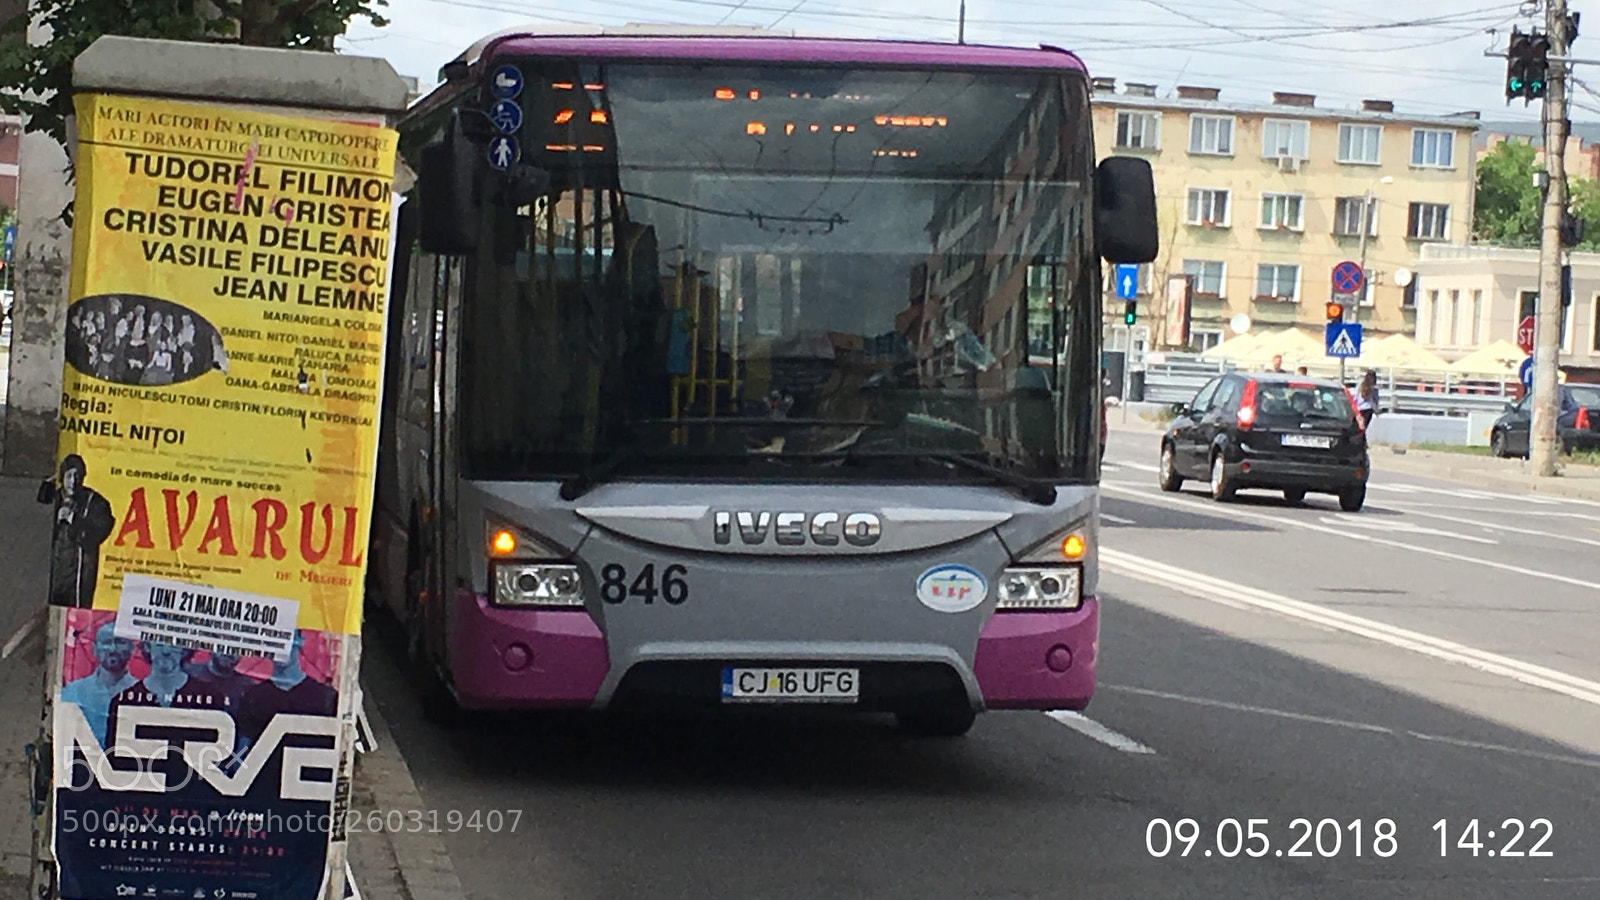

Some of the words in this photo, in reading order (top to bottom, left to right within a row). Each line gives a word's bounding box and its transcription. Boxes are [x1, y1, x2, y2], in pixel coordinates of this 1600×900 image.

[99, 106, 141, 124] MARI
[146, 112, 209, 131] ACTORI
[238, 122, 280, 138] MARI
[284, 127, 388, 152] CAPODOPERE
[107, 127, 138, 142] ALE
[143, 130, 273, 158] DRAMATURGEI
[279, 146, 380, 170] UNIVERSALE
[125, 152, 270, 190] TUDOREL
[158, 185, 264, 218] EUGEN
[103, 208, 249, 245] CRISTINA
[259, 224, 388, 261] DELEANU
[141, 240, 241, 272] VASILE
[250, 252, 386, 287] FILIPESCU
[213, 275, 288, 304] JEAN
[297, 286, 385, 314] LEMNE
[263, 310, 341, 328] MARIANGELA
[220, 326, 263, 341] DANIEL
[302, 335, 345, 349] DANIEL
[294, 347, 341, 362] RALUCA
[61, 392, 114, 415] Regia:
[73, 382, 105, 395] MIHAI
[108, 386, 177, 404] NICULESCU
[179, 394, 210, 408] TOMI
[60, 416, 124, 438] DANIEL
[126, 467, 180, 483] comedia
[181, 472, 197, 484] de
[201, 476, 233, 487] mare
[236, 480, 282, 493] succes
[114, 486, 363, 568] AVARUL
[712, 511, 882, 547] IVECO
[600, 563, 690, 606] 846
[149, 587, 177, 610] LUNI
[179, 591, 195, 612] 21
[195, 594, 219, 616] MAI
[219, 598, 243, 620] ORA
[244, 602, 278, 626] 20:00
[118, 691, 153, 702] JOJO
[164, 694, 213, 705] MAYER
[739, 671, 769, 693] CJ
[777, 672, 798, 693] 16
[803, 672, 853, 693] UFG
[54, 701, 338, 801] NERVE
[89, 838, 158, 850] CONCERT
[108, 822, 147, 833] OPEN
